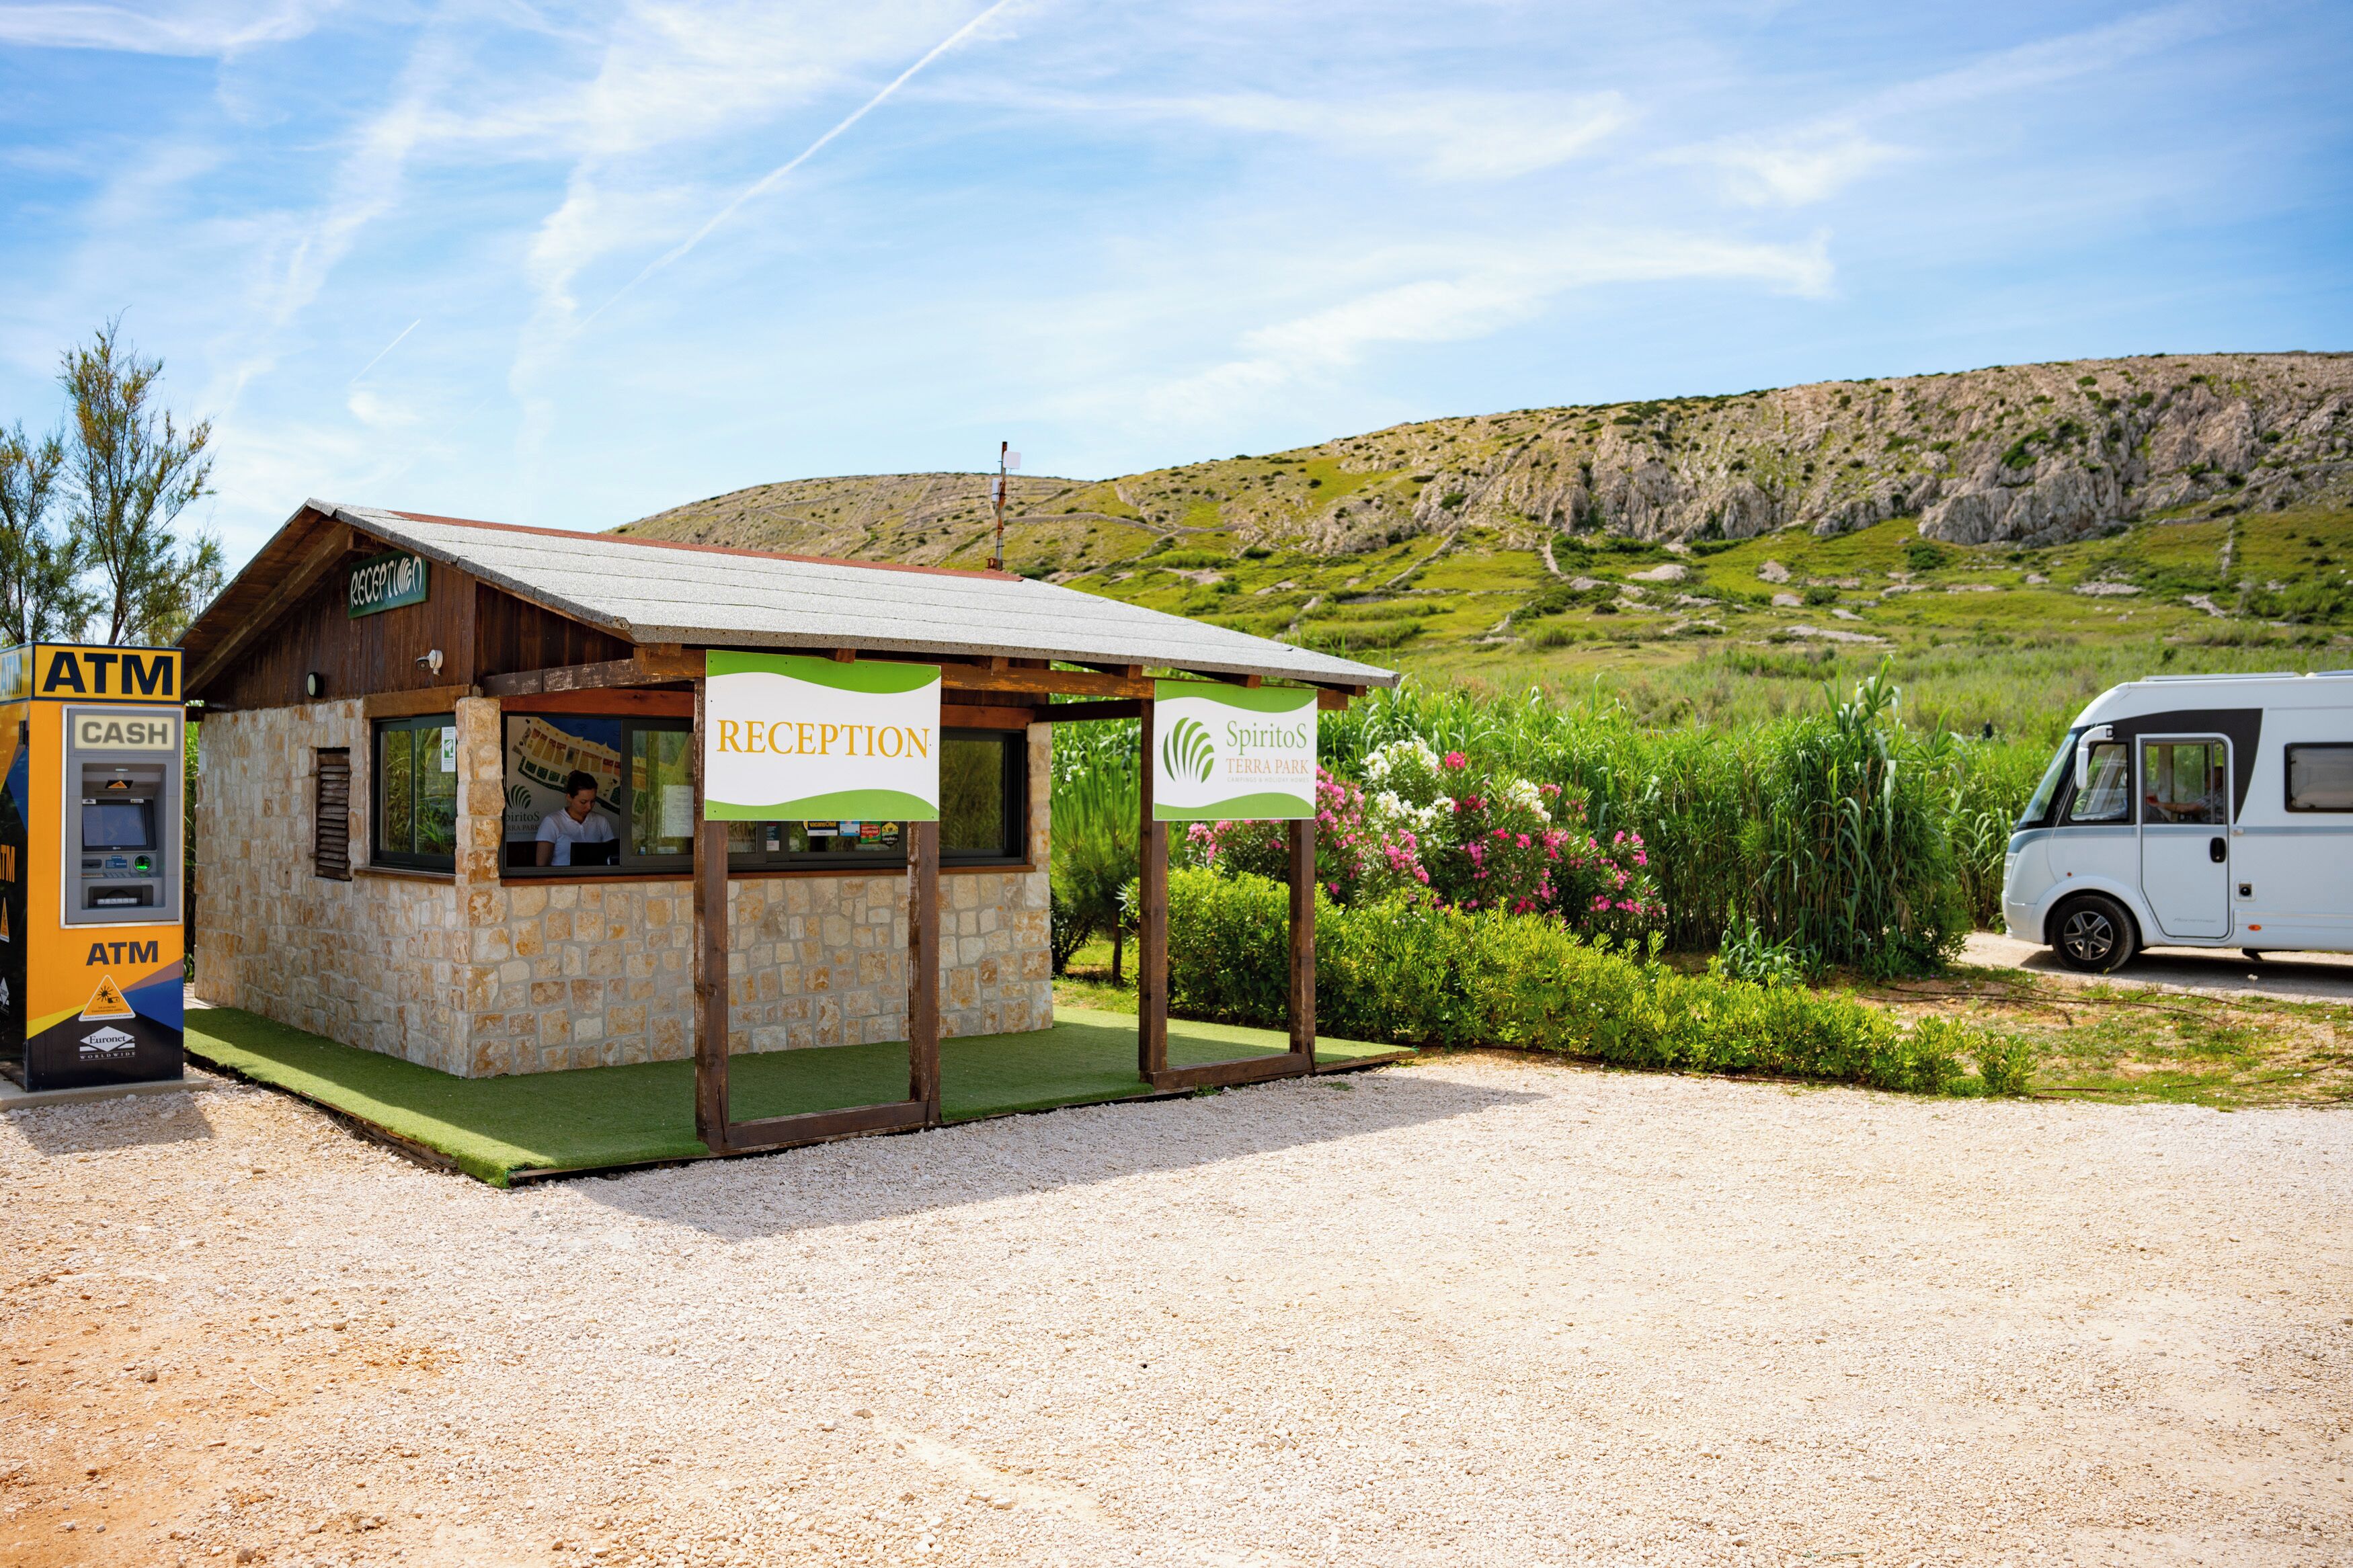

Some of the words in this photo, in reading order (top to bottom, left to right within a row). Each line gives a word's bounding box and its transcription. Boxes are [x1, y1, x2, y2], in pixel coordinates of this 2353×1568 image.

[0, 653, 22, 696] ATM
[42, 651, 173, 696] ATM
[82, 721, 168, 745] CASH
[717, 720, 930, 759] RECEPTION
[1226, 720, 1307, 755] SpiritoS
[1226, 758, 1271, 774] TERRA
[1275, 759, 1309, 774] PARK
[86, 941, 159, 966] ATM
[89, 1036, 126, 1044] Euronet
